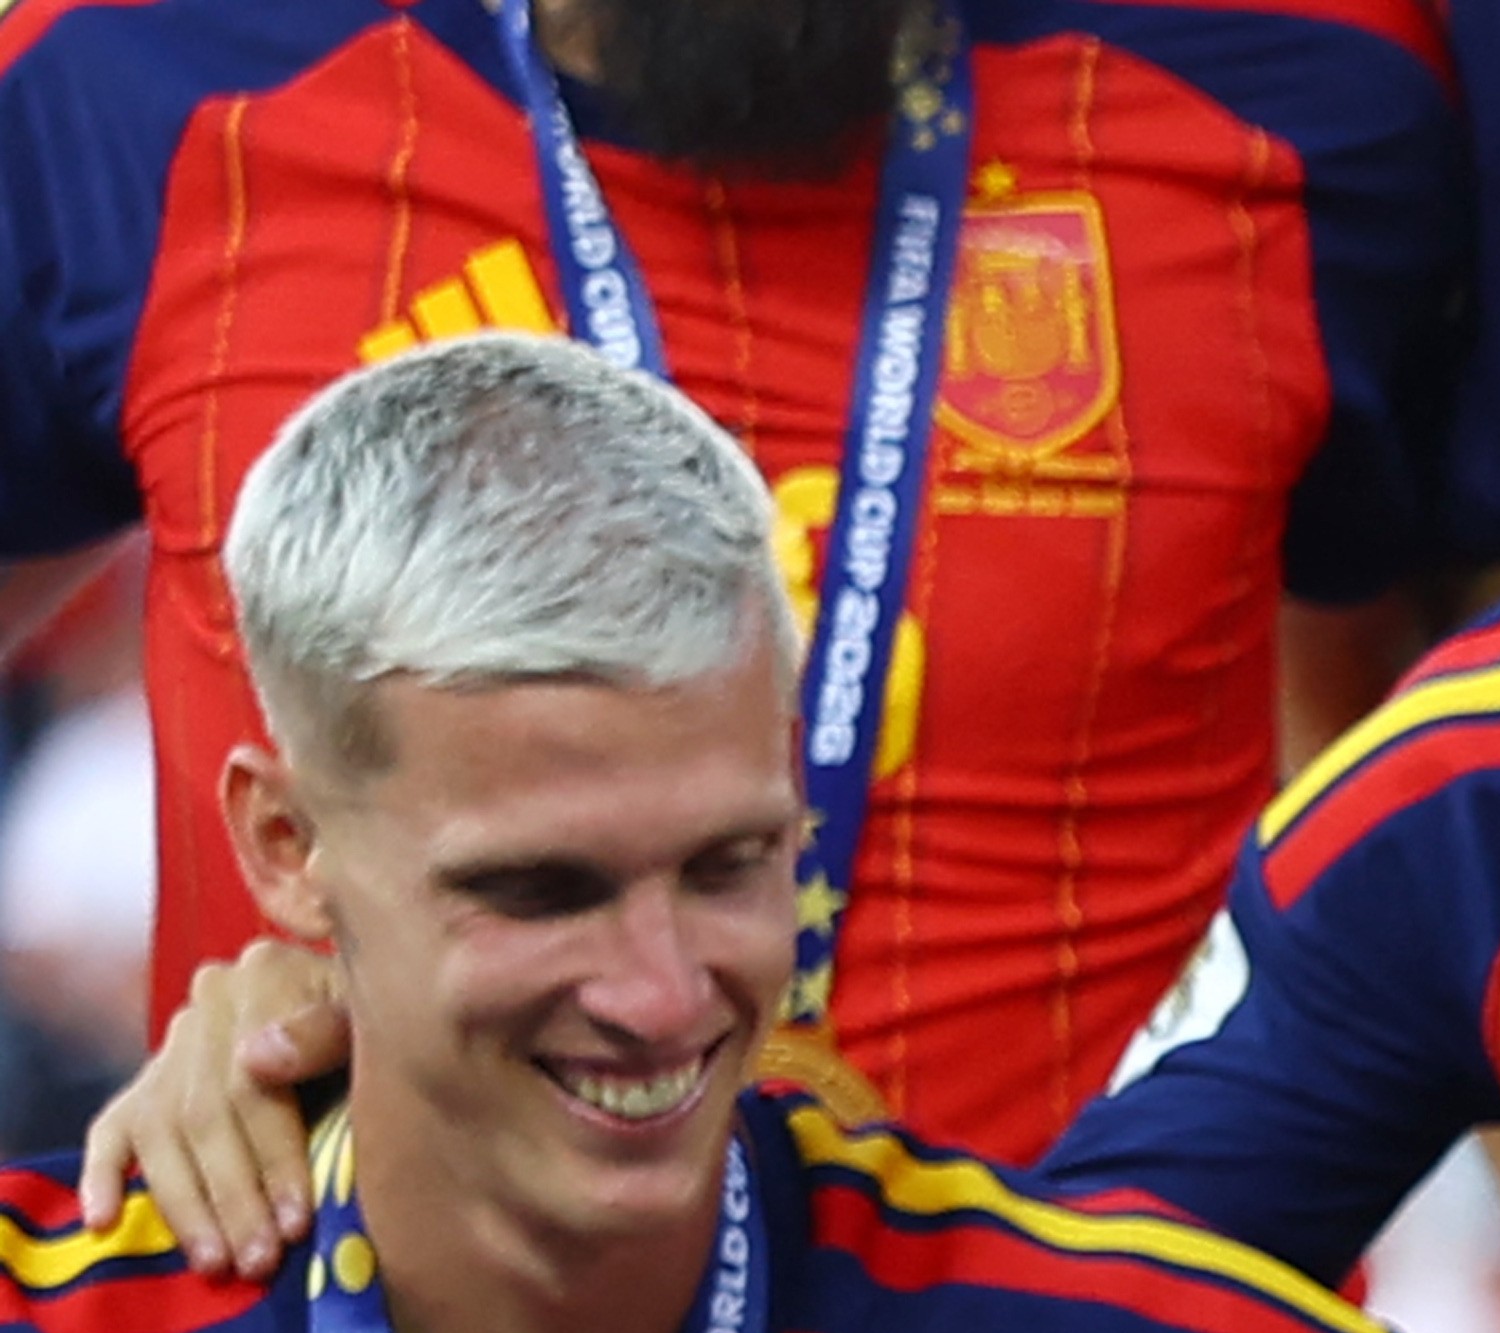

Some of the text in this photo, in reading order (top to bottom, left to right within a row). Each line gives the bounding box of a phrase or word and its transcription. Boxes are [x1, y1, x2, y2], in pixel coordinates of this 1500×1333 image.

[809, 194, 940, 766] FIFA WORLD CUP 2026
